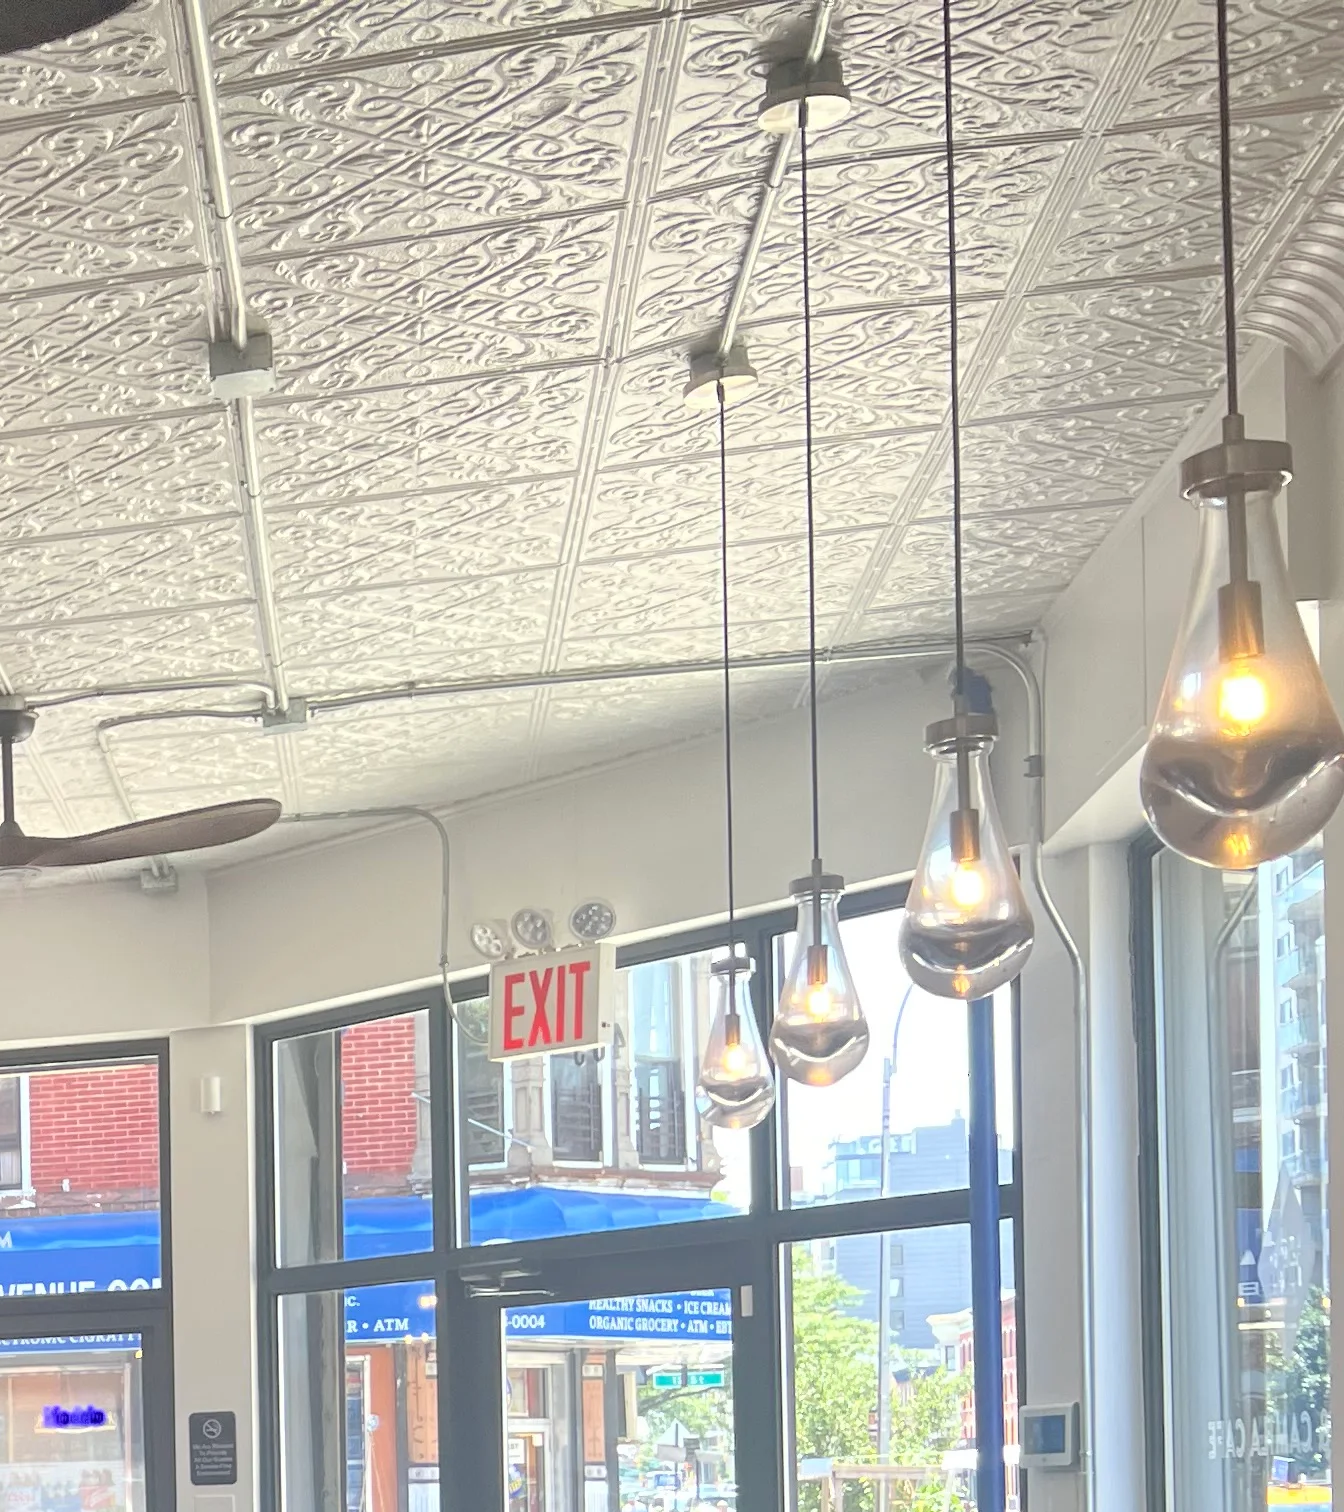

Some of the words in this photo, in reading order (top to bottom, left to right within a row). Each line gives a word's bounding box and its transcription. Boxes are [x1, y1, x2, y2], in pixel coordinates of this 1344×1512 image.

[502, 961, 591, 1052] EXIT
[373, 1318, 410, 1333] ATM
[589, 1316, 634, 1331] ORGANIC
[635, 1317, 679, 1333] GROCERY
[687, 1319, 708, 1334] ATM
